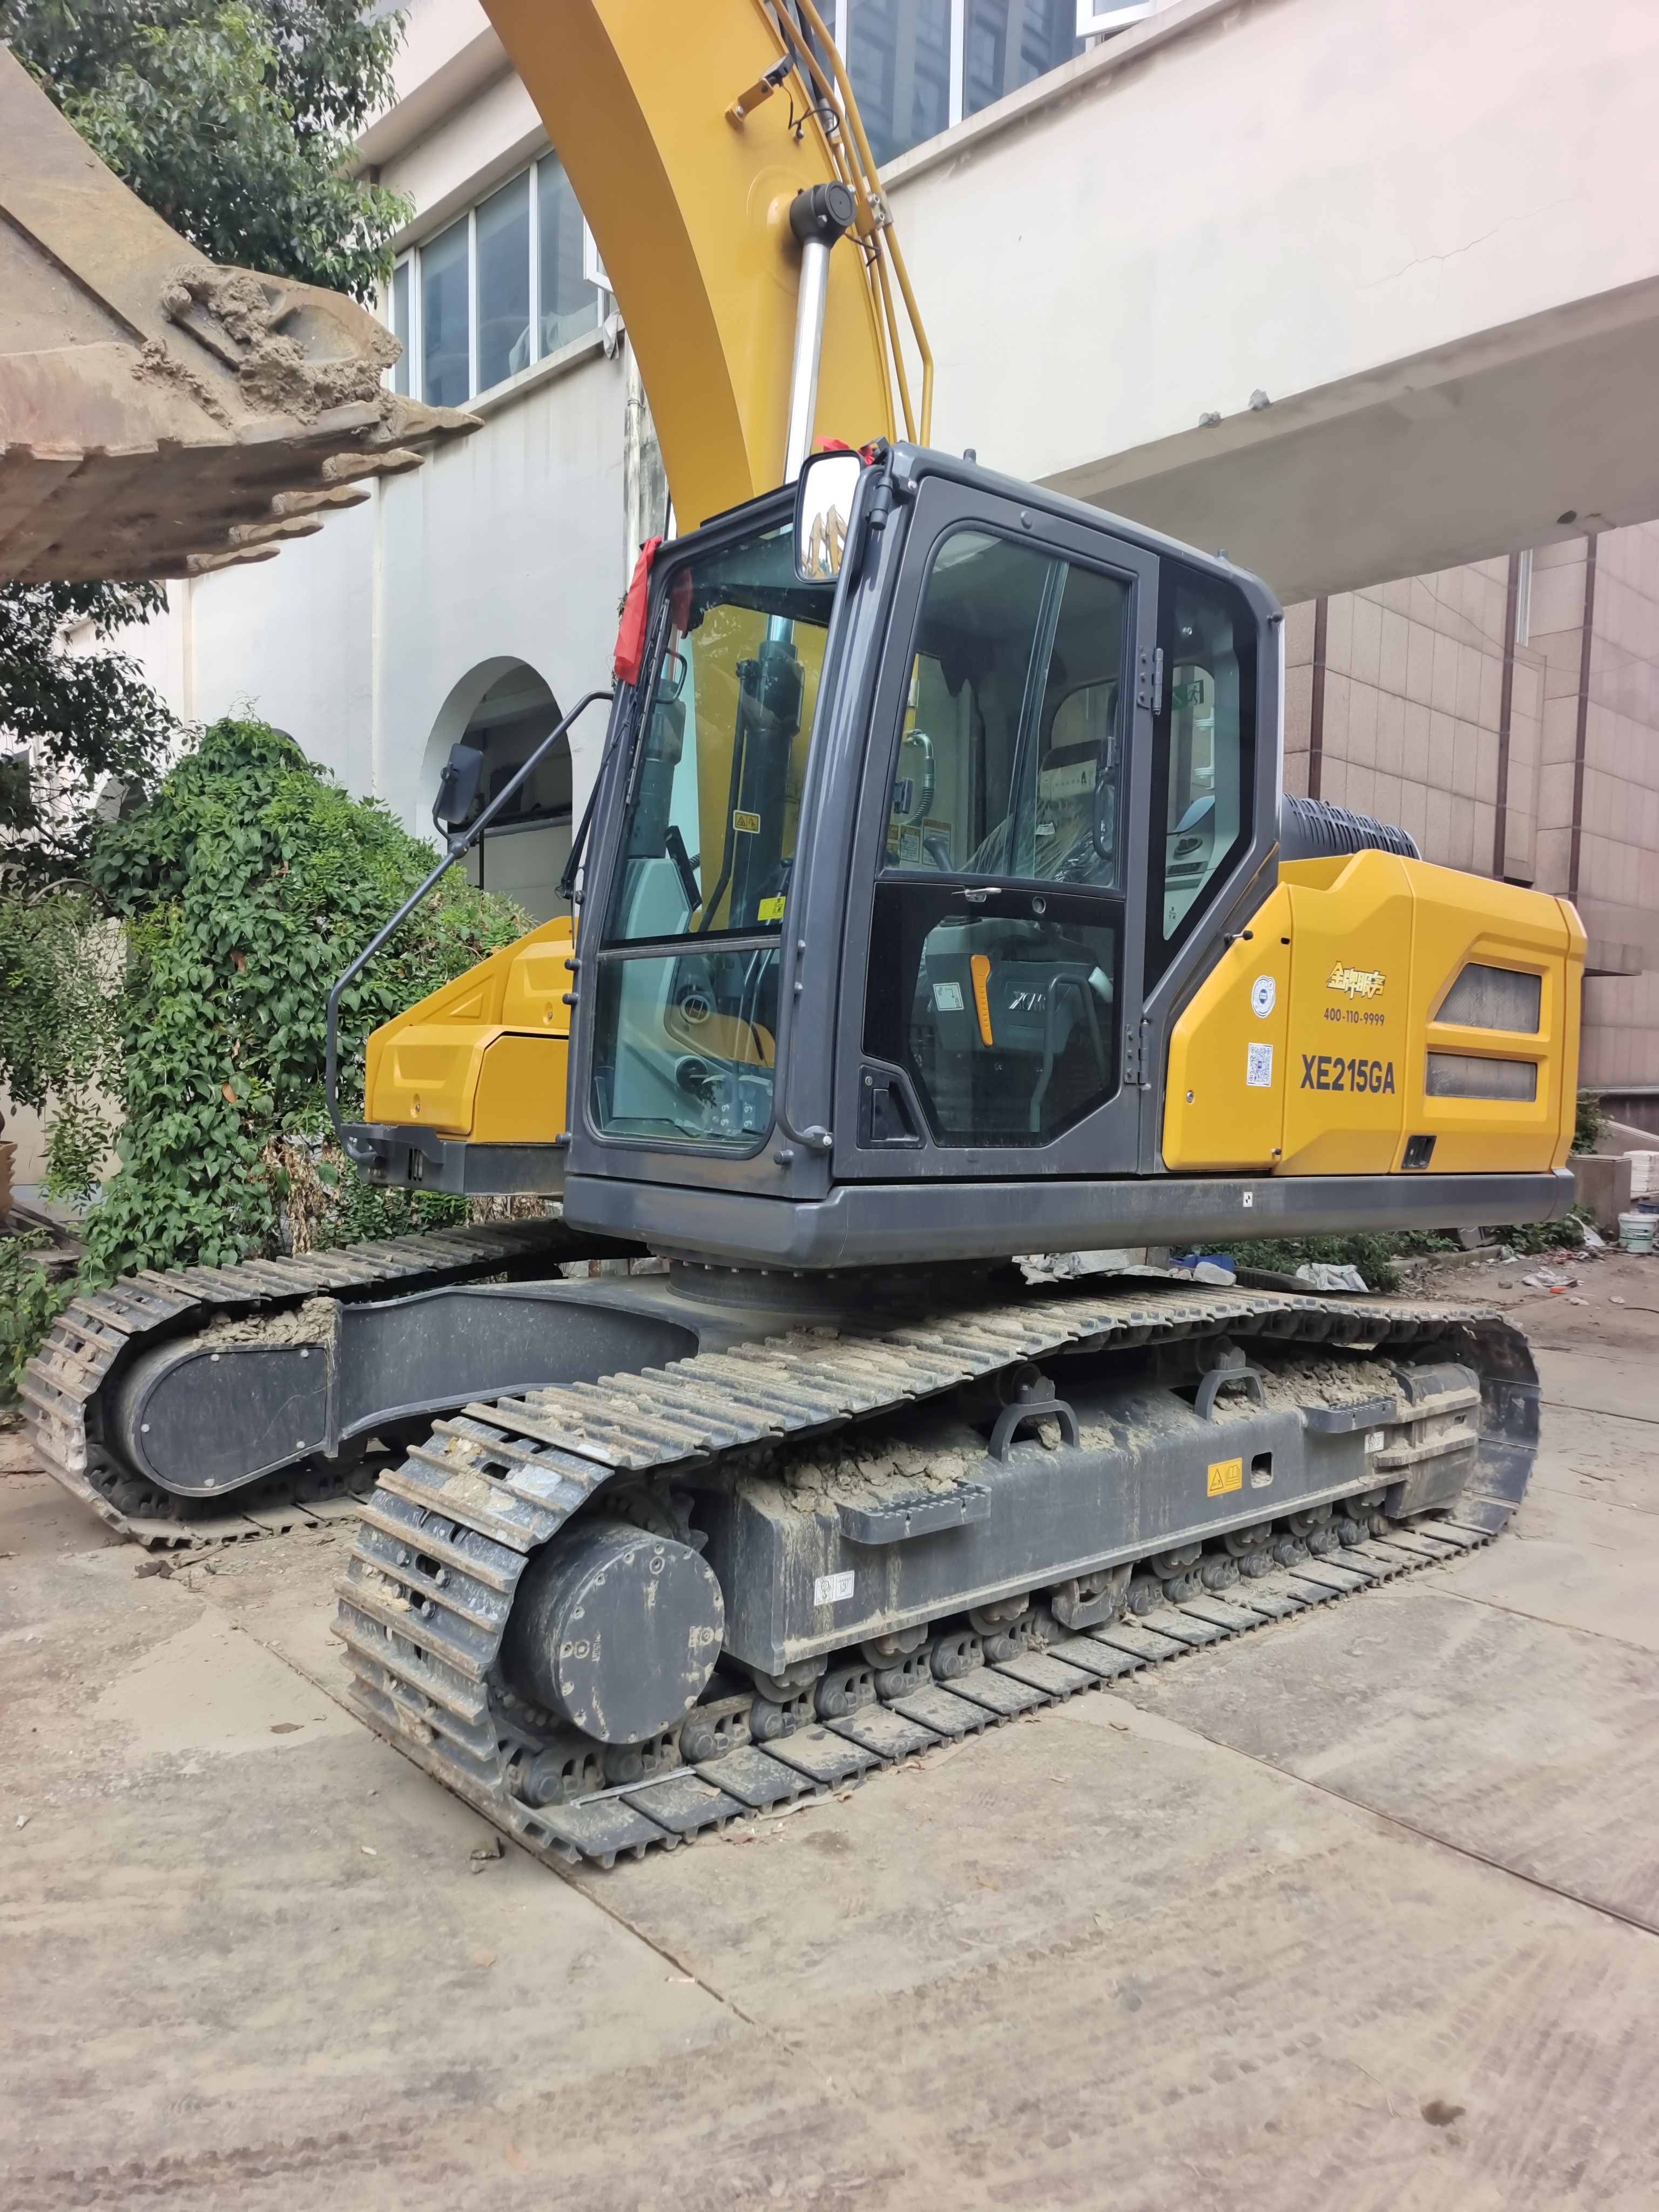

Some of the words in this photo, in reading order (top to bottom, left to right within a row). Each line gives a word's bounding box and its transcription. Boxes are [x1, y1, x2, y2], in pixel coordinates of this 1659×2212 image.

[1326, 961, 1386, 1000] 金牌服务
[1324, 1008, 1385, 1026] 400-110-9999
[1300, 1054, 1395, 1094] XE215GA
